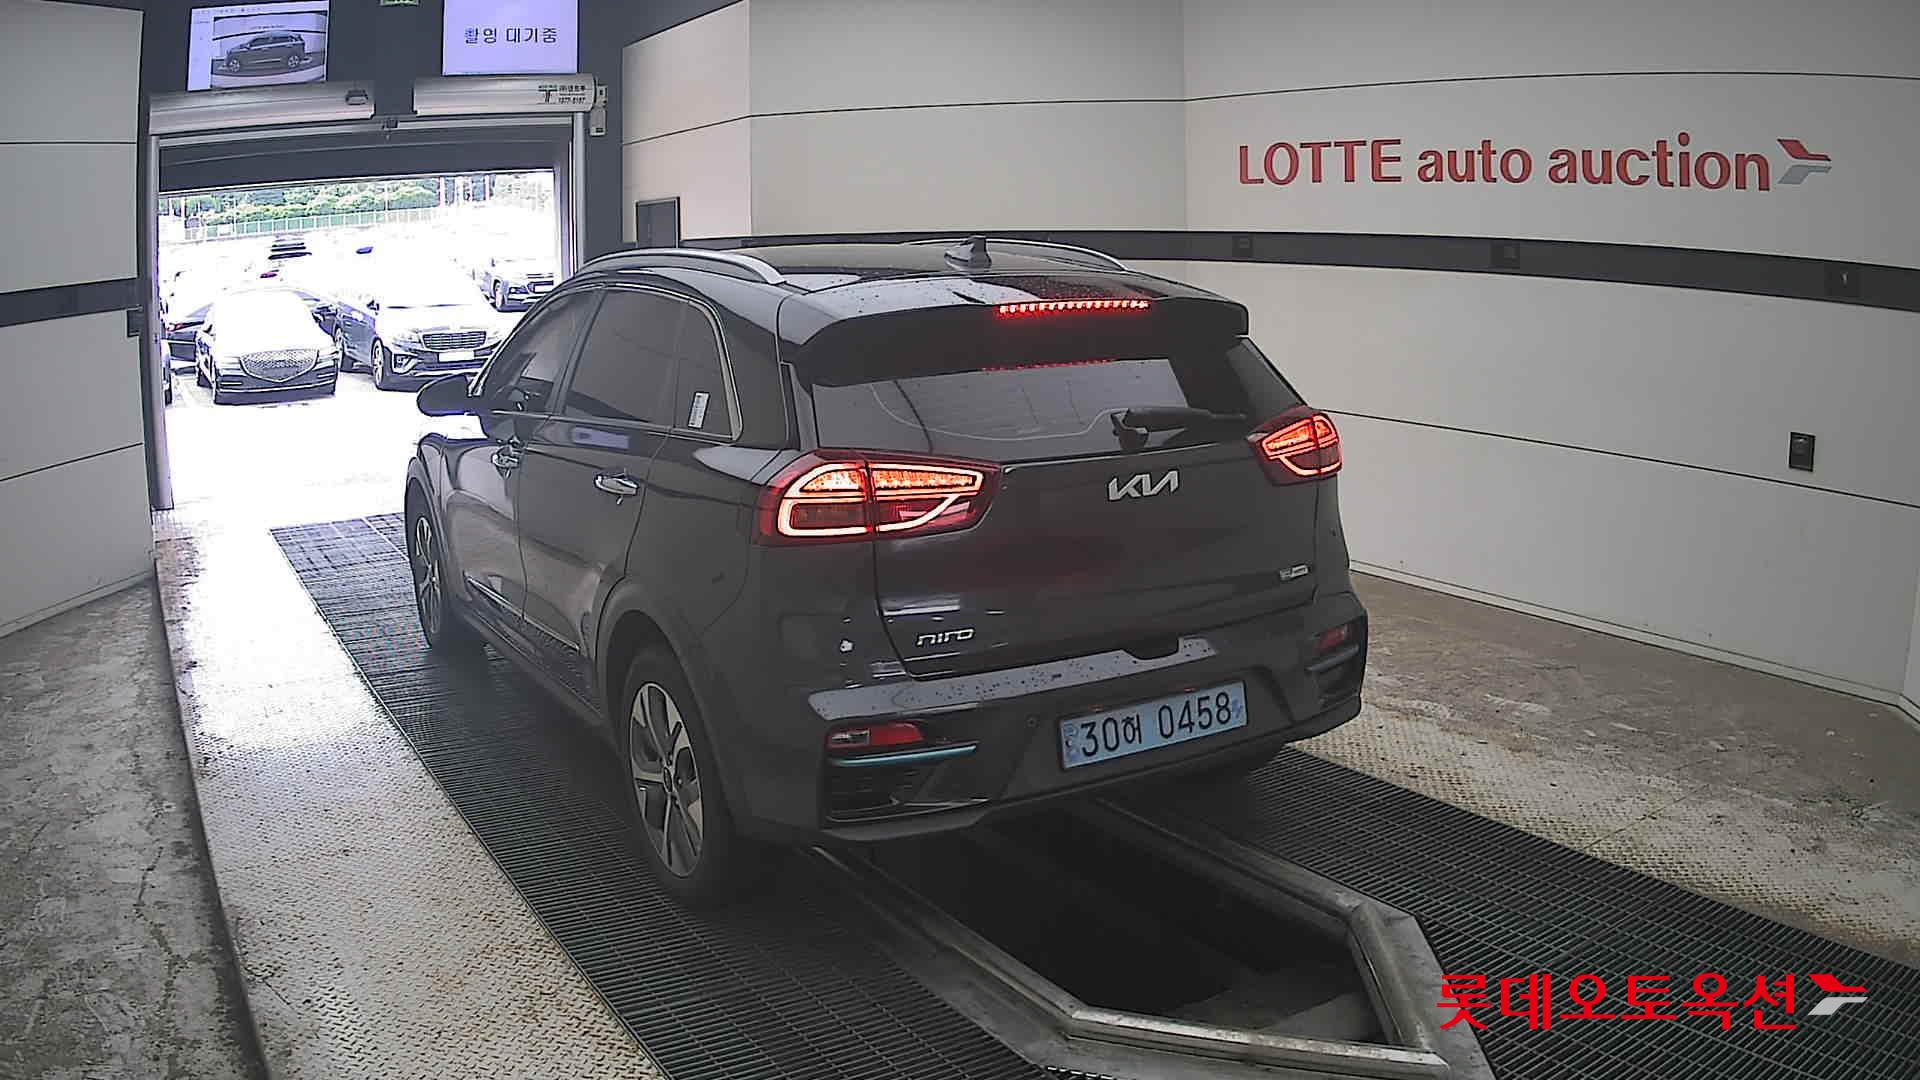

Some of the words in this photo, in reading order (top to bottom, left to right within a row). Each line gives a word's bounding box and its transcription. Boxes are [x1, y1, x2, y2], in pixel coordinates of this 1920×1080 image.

[506, 27, 559, 44] 대기중
[1239, 138, 1402, 186] LOTTE
[1417, 139, 1533, 185] auto
[1547, 131, 1771, 192] auction
[1108, 469, 1179, 501] KIA
[1080, 713, 1143, 757] 30허
[1158, 691, 1232, 739] 0458
